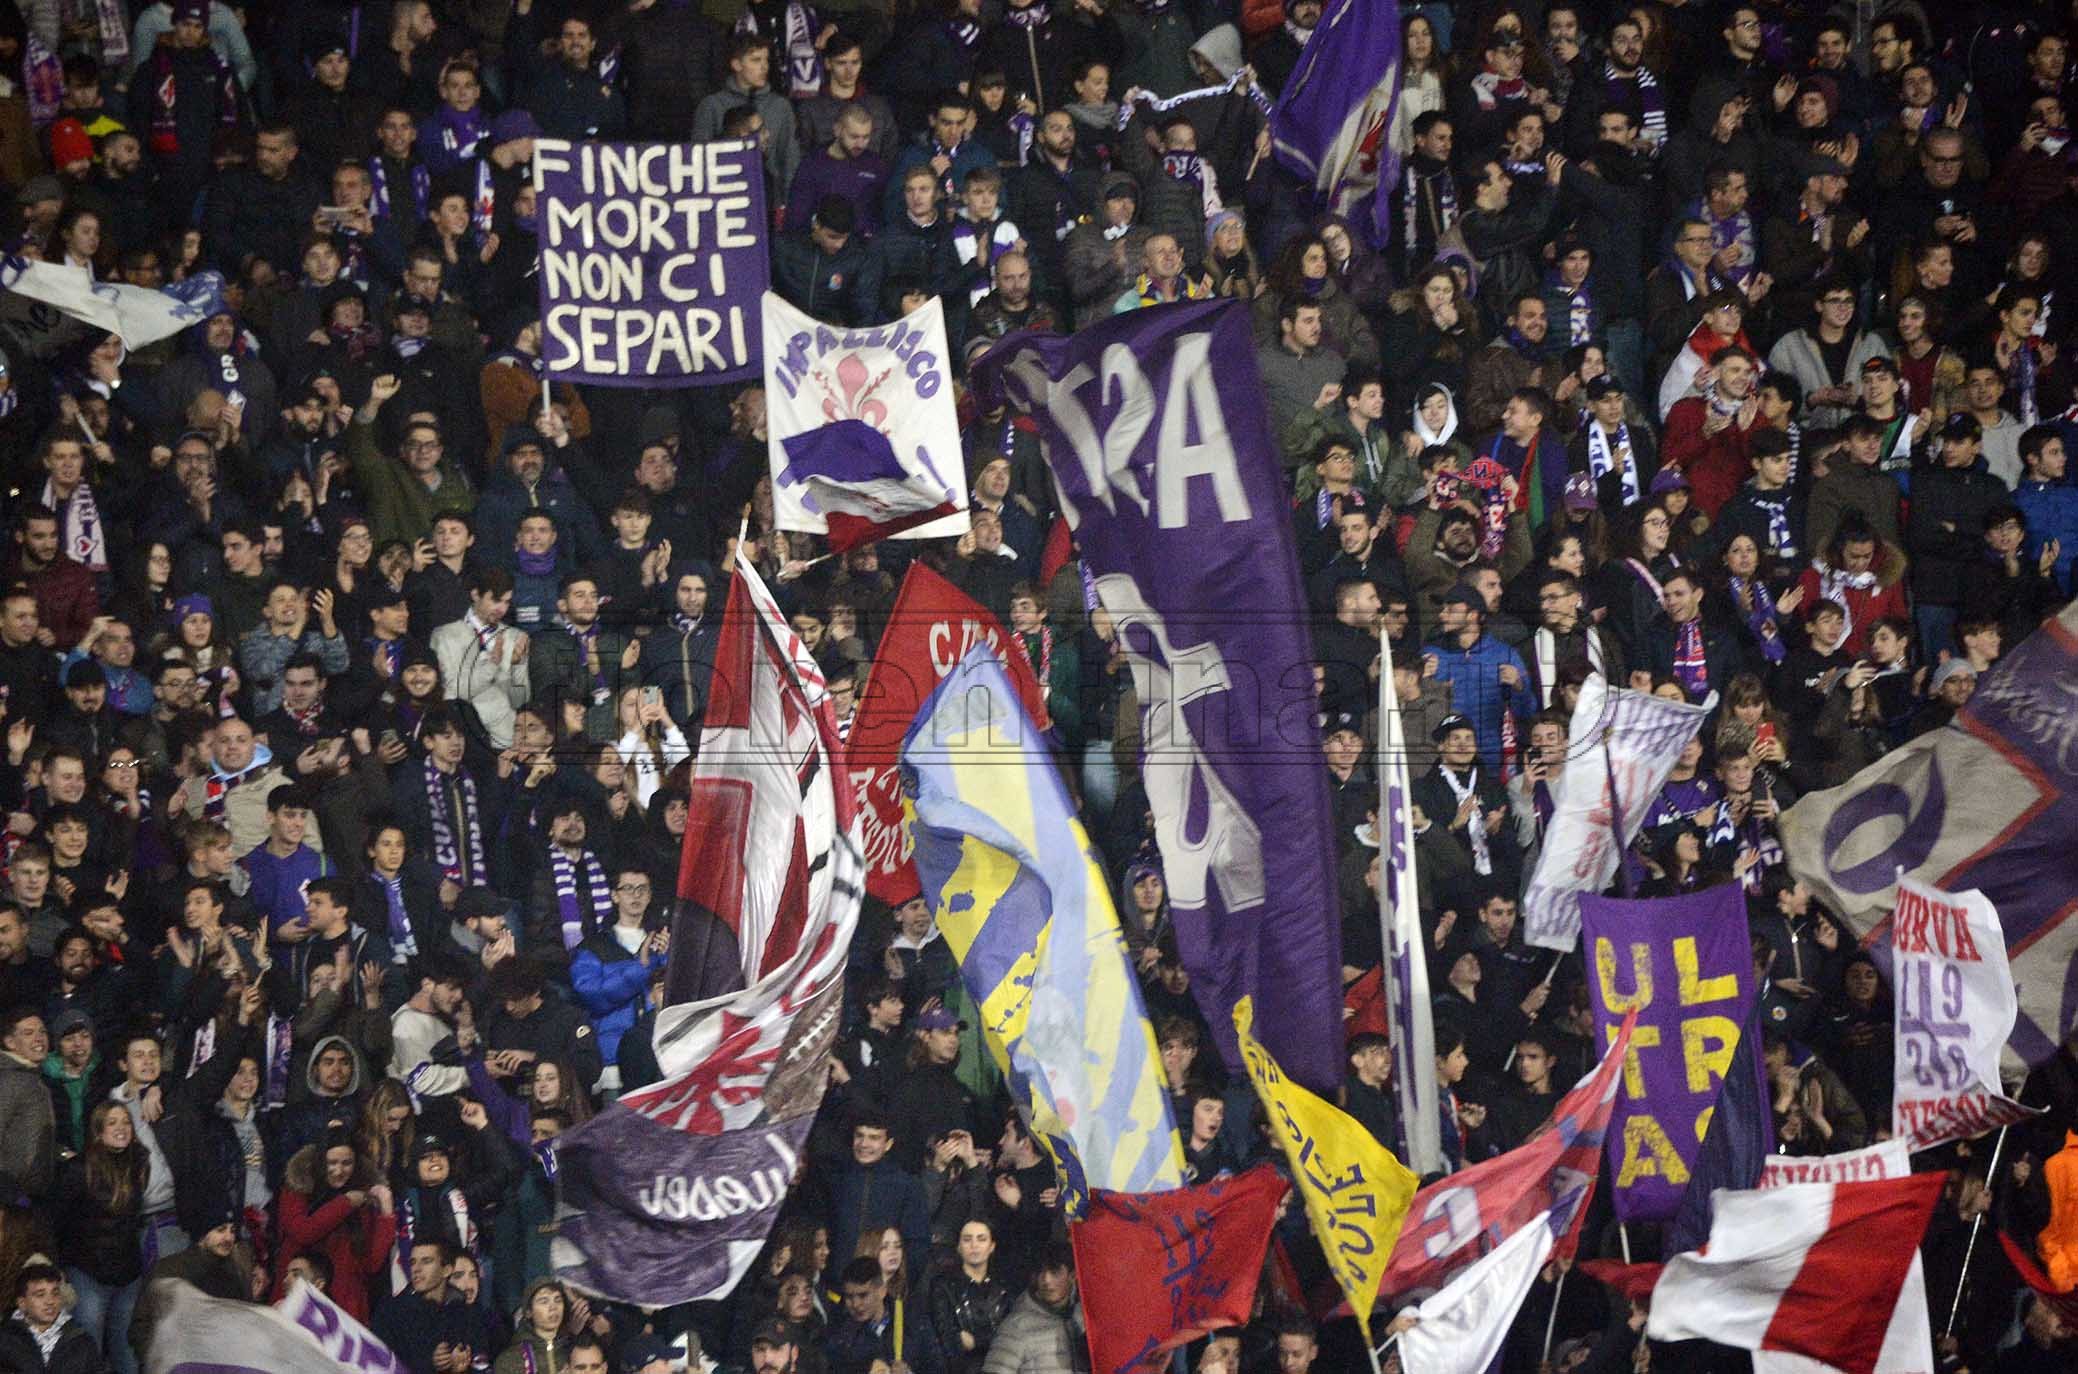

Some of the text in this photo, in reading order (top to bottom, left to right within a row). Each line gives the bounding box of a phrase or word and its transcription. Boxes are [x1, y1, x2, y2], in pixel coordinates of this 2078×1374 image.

[548, 197, 757, 252] MORTE
[544, 247, 727, 302] NON CI
[546, 304, 748, 376] SEPARI
